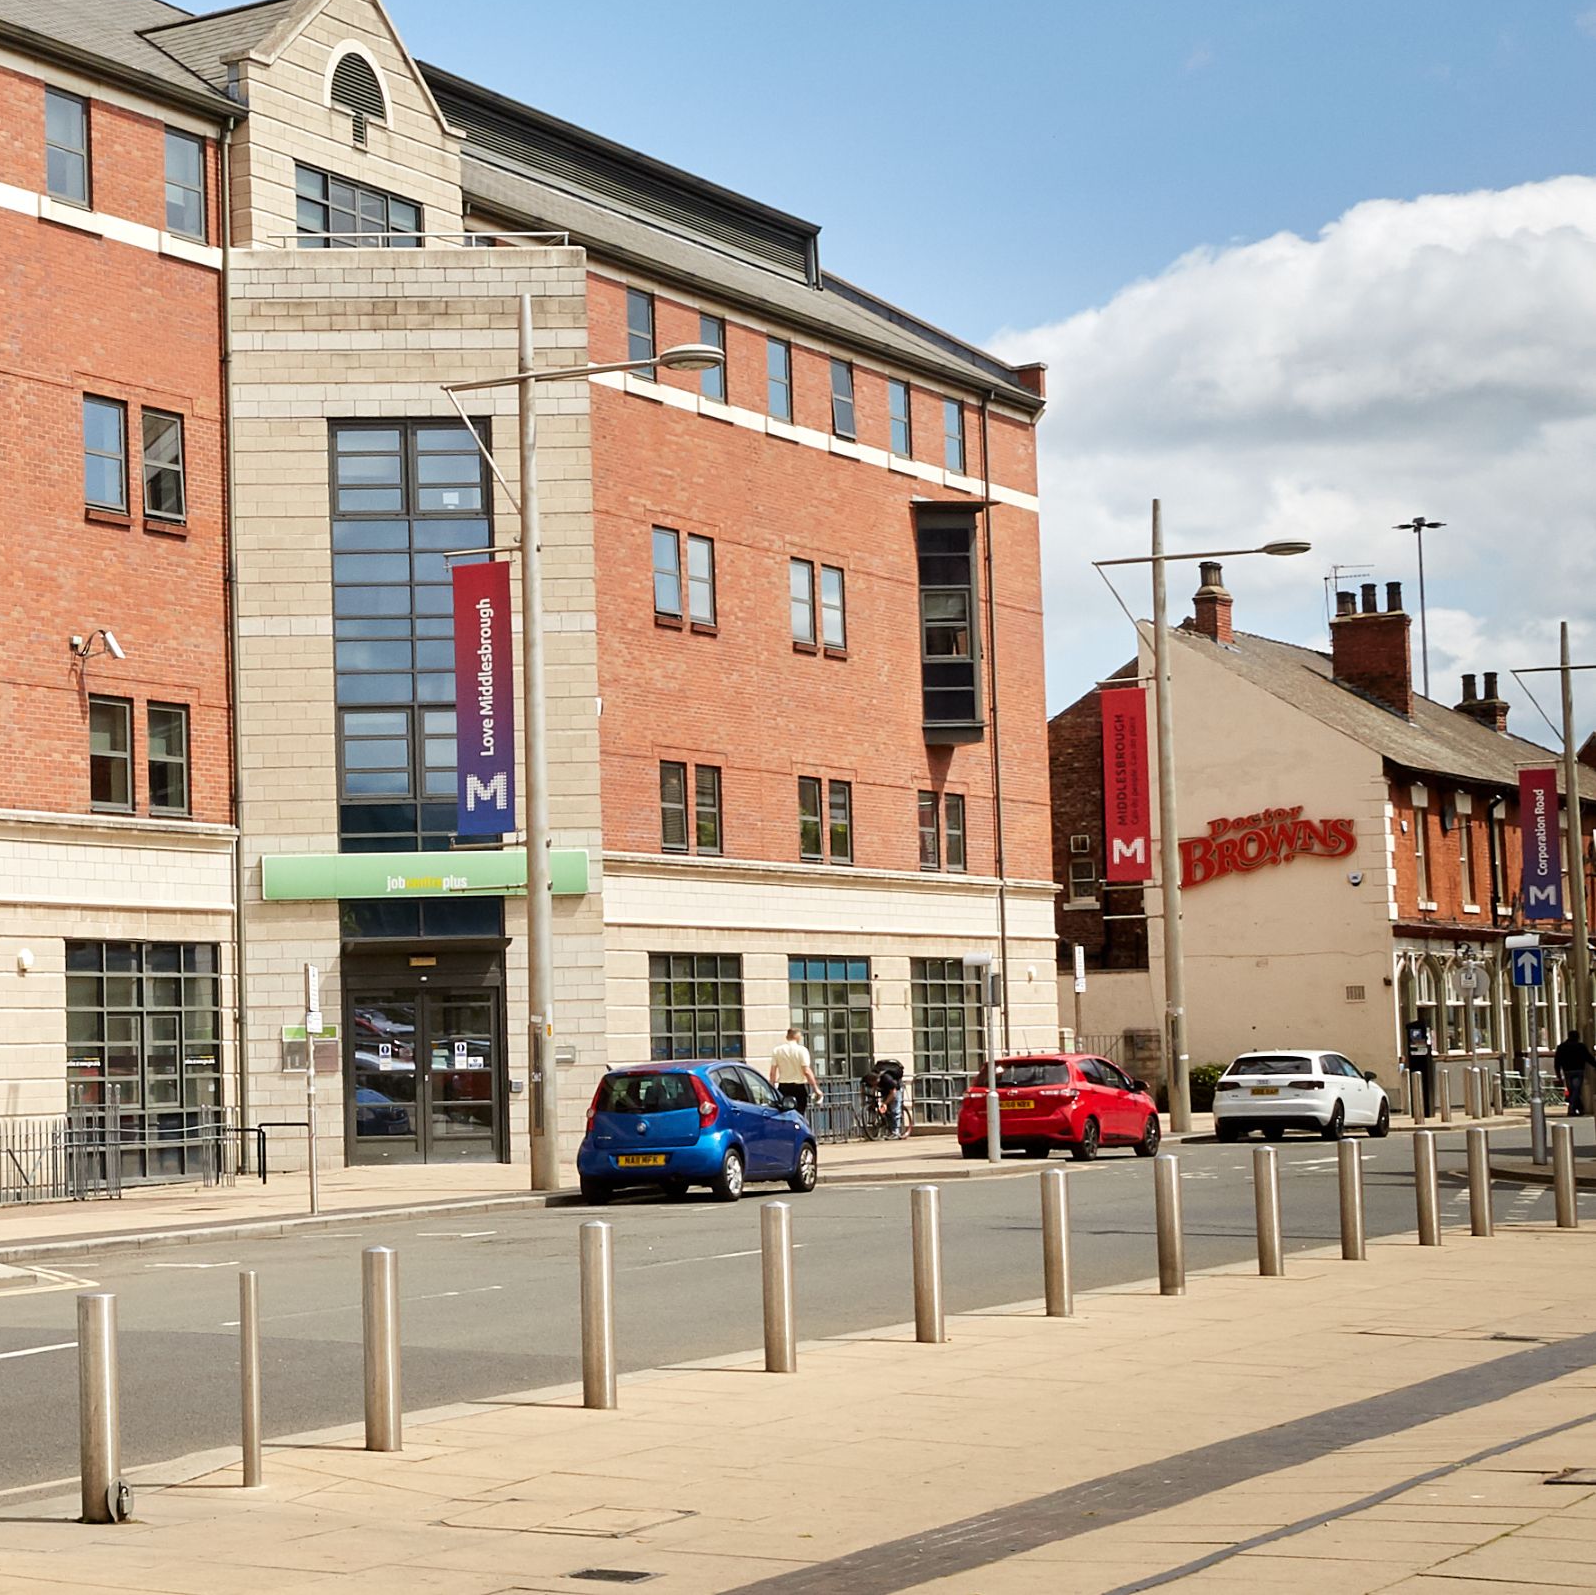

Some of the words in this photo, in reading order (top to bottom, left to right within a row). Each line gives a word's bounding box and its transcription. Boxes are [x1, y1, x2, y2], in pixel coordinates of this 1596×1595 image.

[475, 598, 495, 716] Middlesbrough
[479, 716, 495, 756] Love
[1114, 714, 1128, 826] MIDDLESBROUGH
[466, 771, 508, 812] M
[1532, 789, 1546, 815] Road
[1207, 805, 1304, 838] Doctor
[1112, 836, 1146, 865] M
[1178, 819, 1357, 891] BROWNS
[1534, 816, 1550, 876] Corporation
